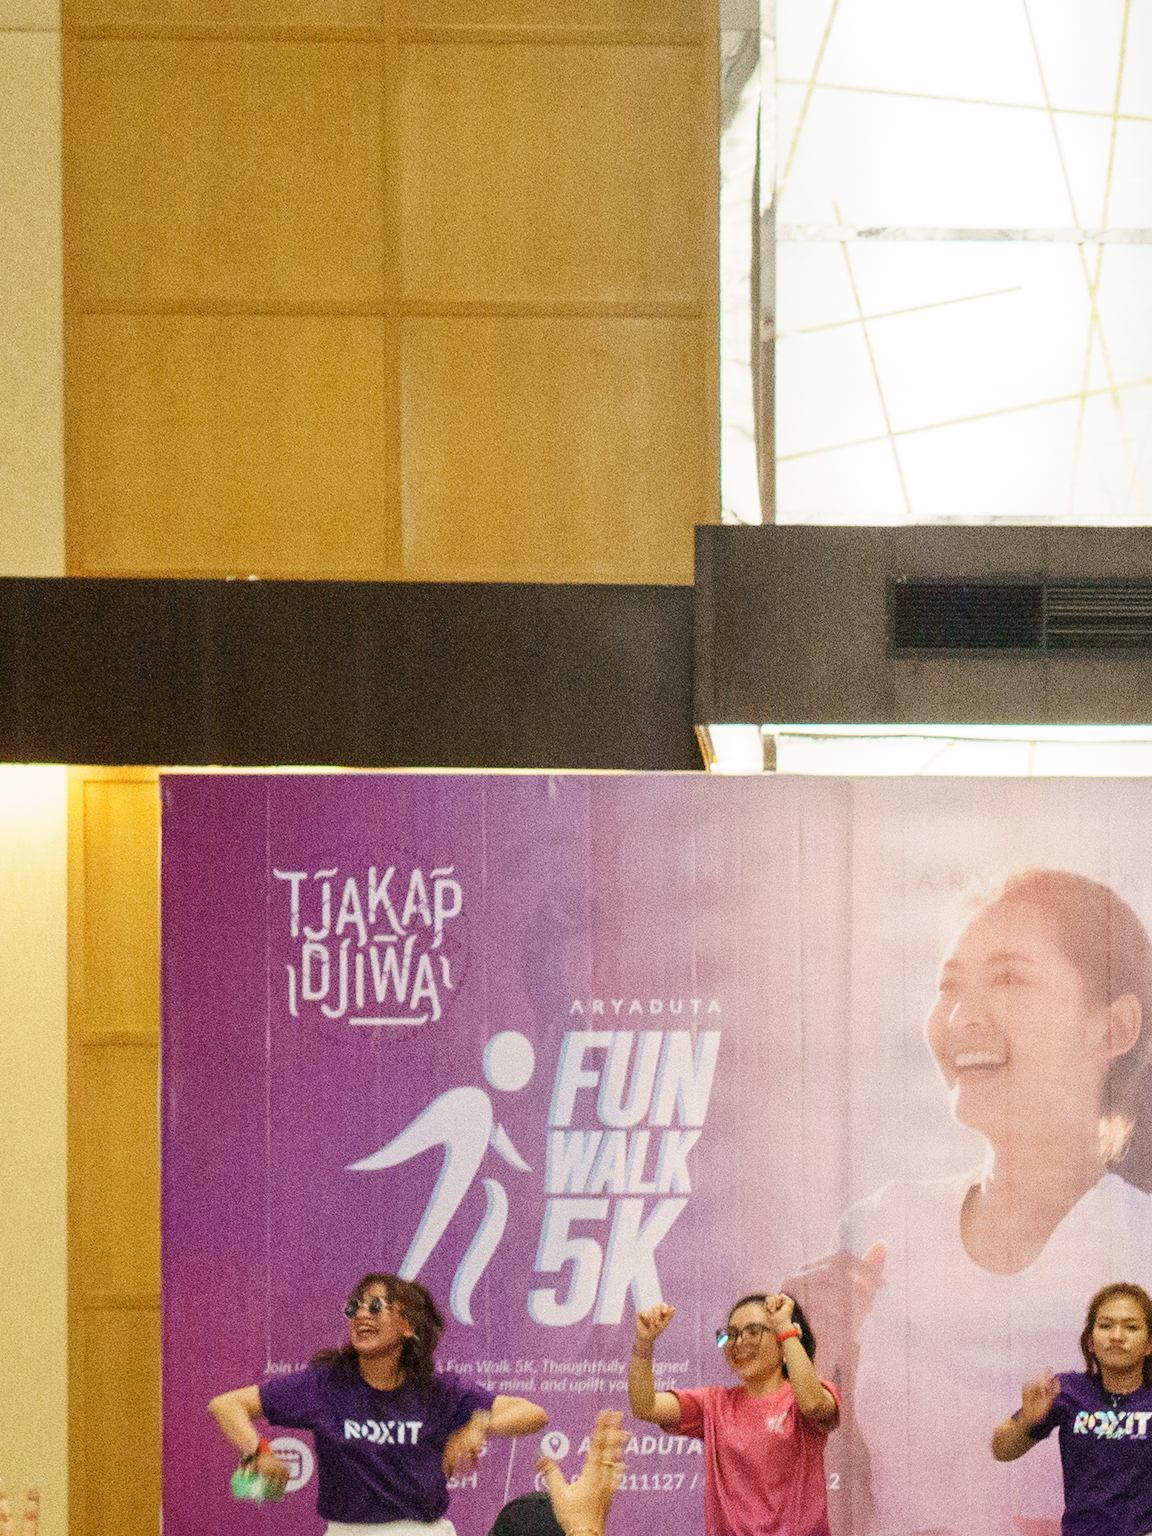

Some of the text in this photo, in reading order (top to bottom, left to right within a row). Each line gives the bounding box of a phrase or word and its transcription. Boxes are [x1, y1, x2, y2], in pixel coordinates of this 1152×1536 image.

[273, 866, 462, 948] TJAKAP
[569, 1000, 722, 1014] ARYADUTA
[548, 1030, 722, 1128] FUN
[544, 1130, 701, 1195] WALK
[528, 1199, 690, 1325] 5K
[263, 1360, 292, 1375] Join
[446, 1359, 473, 1374] Fun
[476, 1359, 510, 1374] Walk
[542, 1359, 627, 1377] Thoughtfully
[499, 1378, 536, 1393] mind,
[540, 1378, 567, 1391] and
[570, 1377, 605, 1394] uplift
[344, 1418, 423, 1445] ROXIT
[577, 1437, 702, 1456] AADUTA
